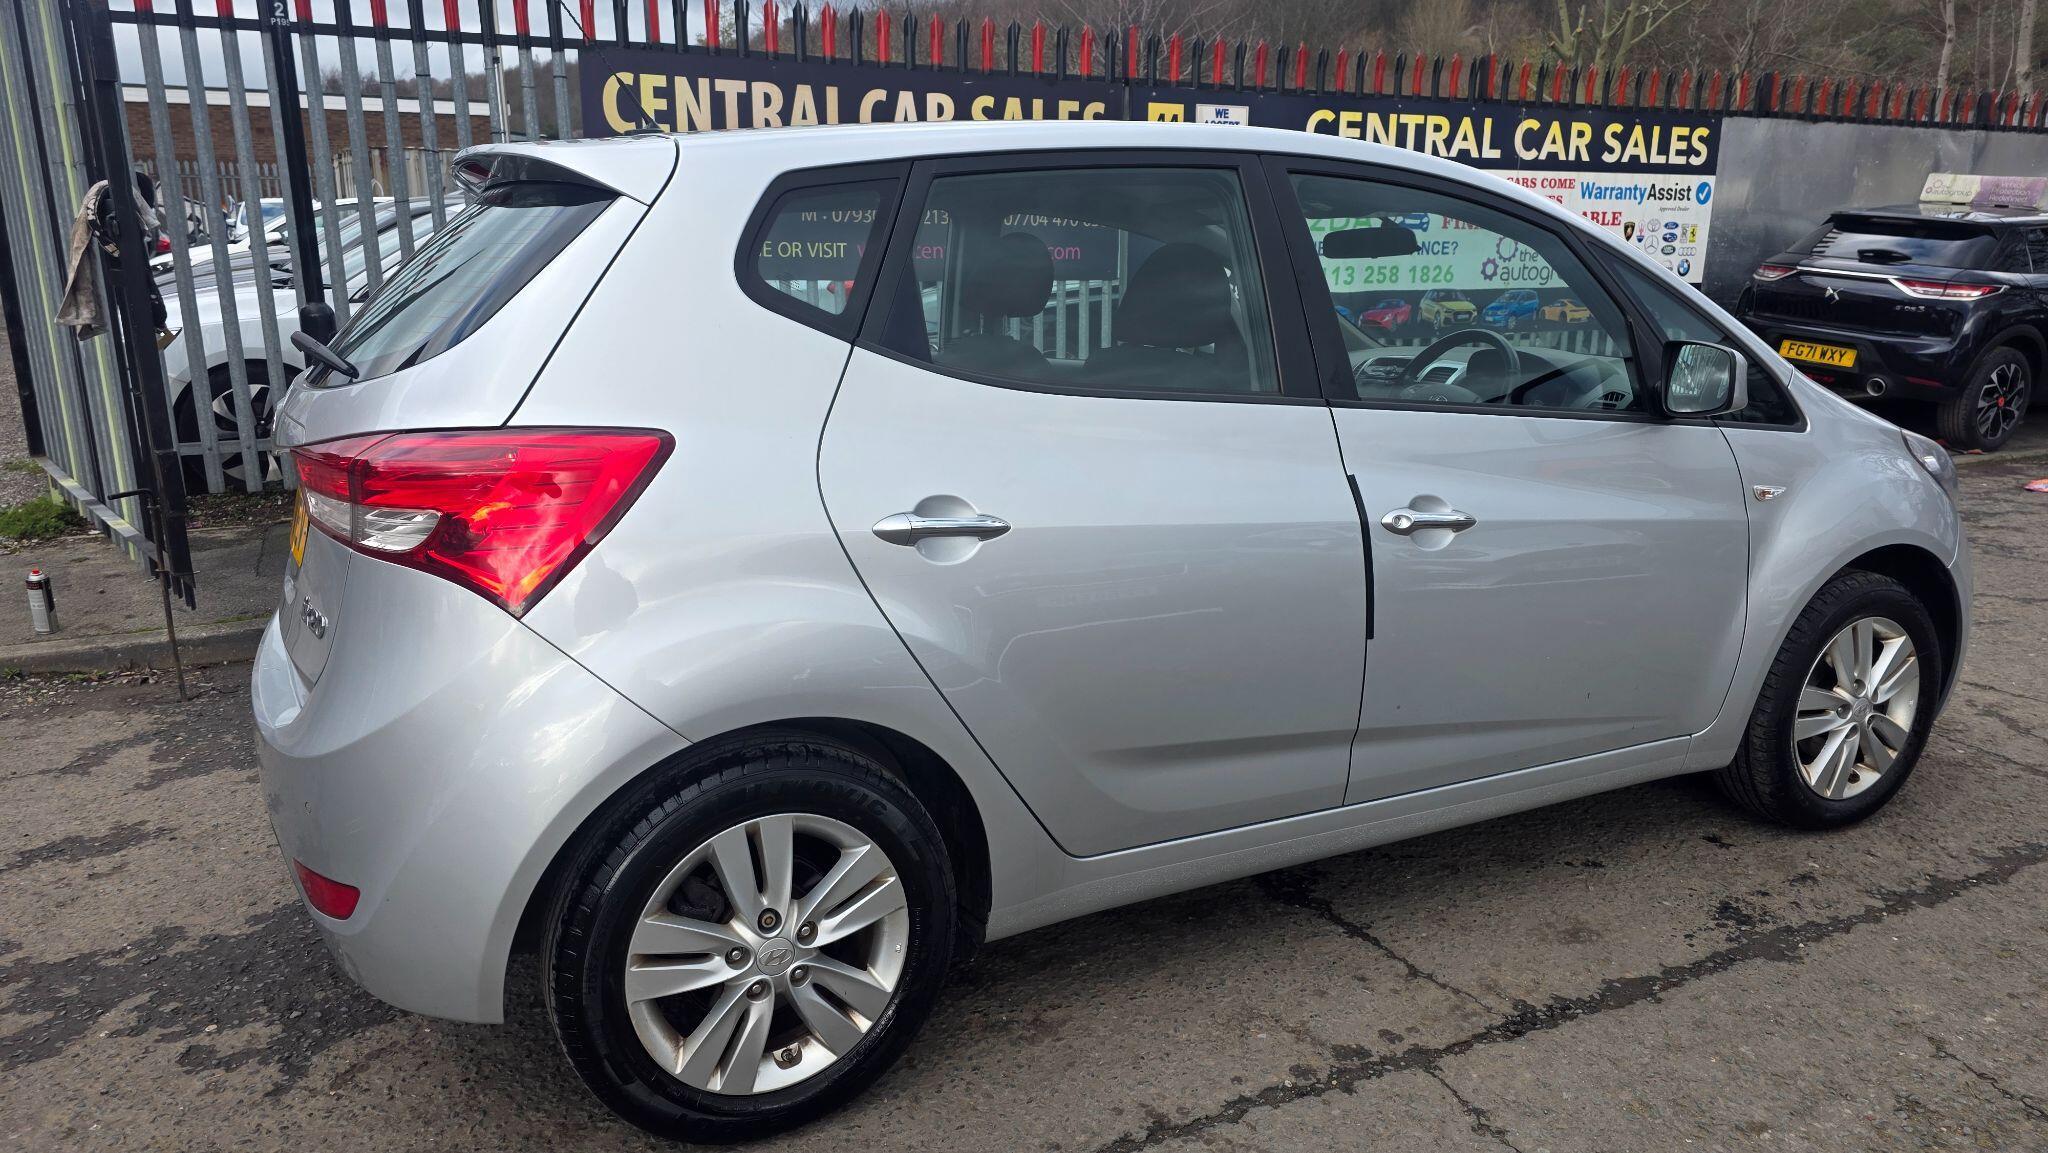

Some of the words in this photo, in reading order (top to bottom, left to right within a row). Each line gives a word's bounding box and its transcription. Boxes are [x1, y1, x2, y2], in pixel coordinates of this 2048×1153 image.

[273, 2, 285, 17] 2
[602, 71, 839, 134] CENTRAL
[1215, 108, 1229, 119] WE
[1305, 109, 1502, 159] CENTRAL
[1514, 118, 1592, 161] CAR
[1601, 122, 1711, 166] SALES
[1540, 178, 1576, 189] COME
[832, 209, 876, 223] 0793
[778, 241, 802, 258] OR
[807, 242, 848, 258] VISIT
[1417, 241, 1459, 256] NCE?
[1520, 248, 1539, 262] the
[1324, 265, 1355, 286] 13
[1363, 265, 1400, 285] 258
[1408, 264, 1455, 284] 1826
[1787, 342, 1818, 359] FG71
[1819, 346, 1848, 363] WXY
